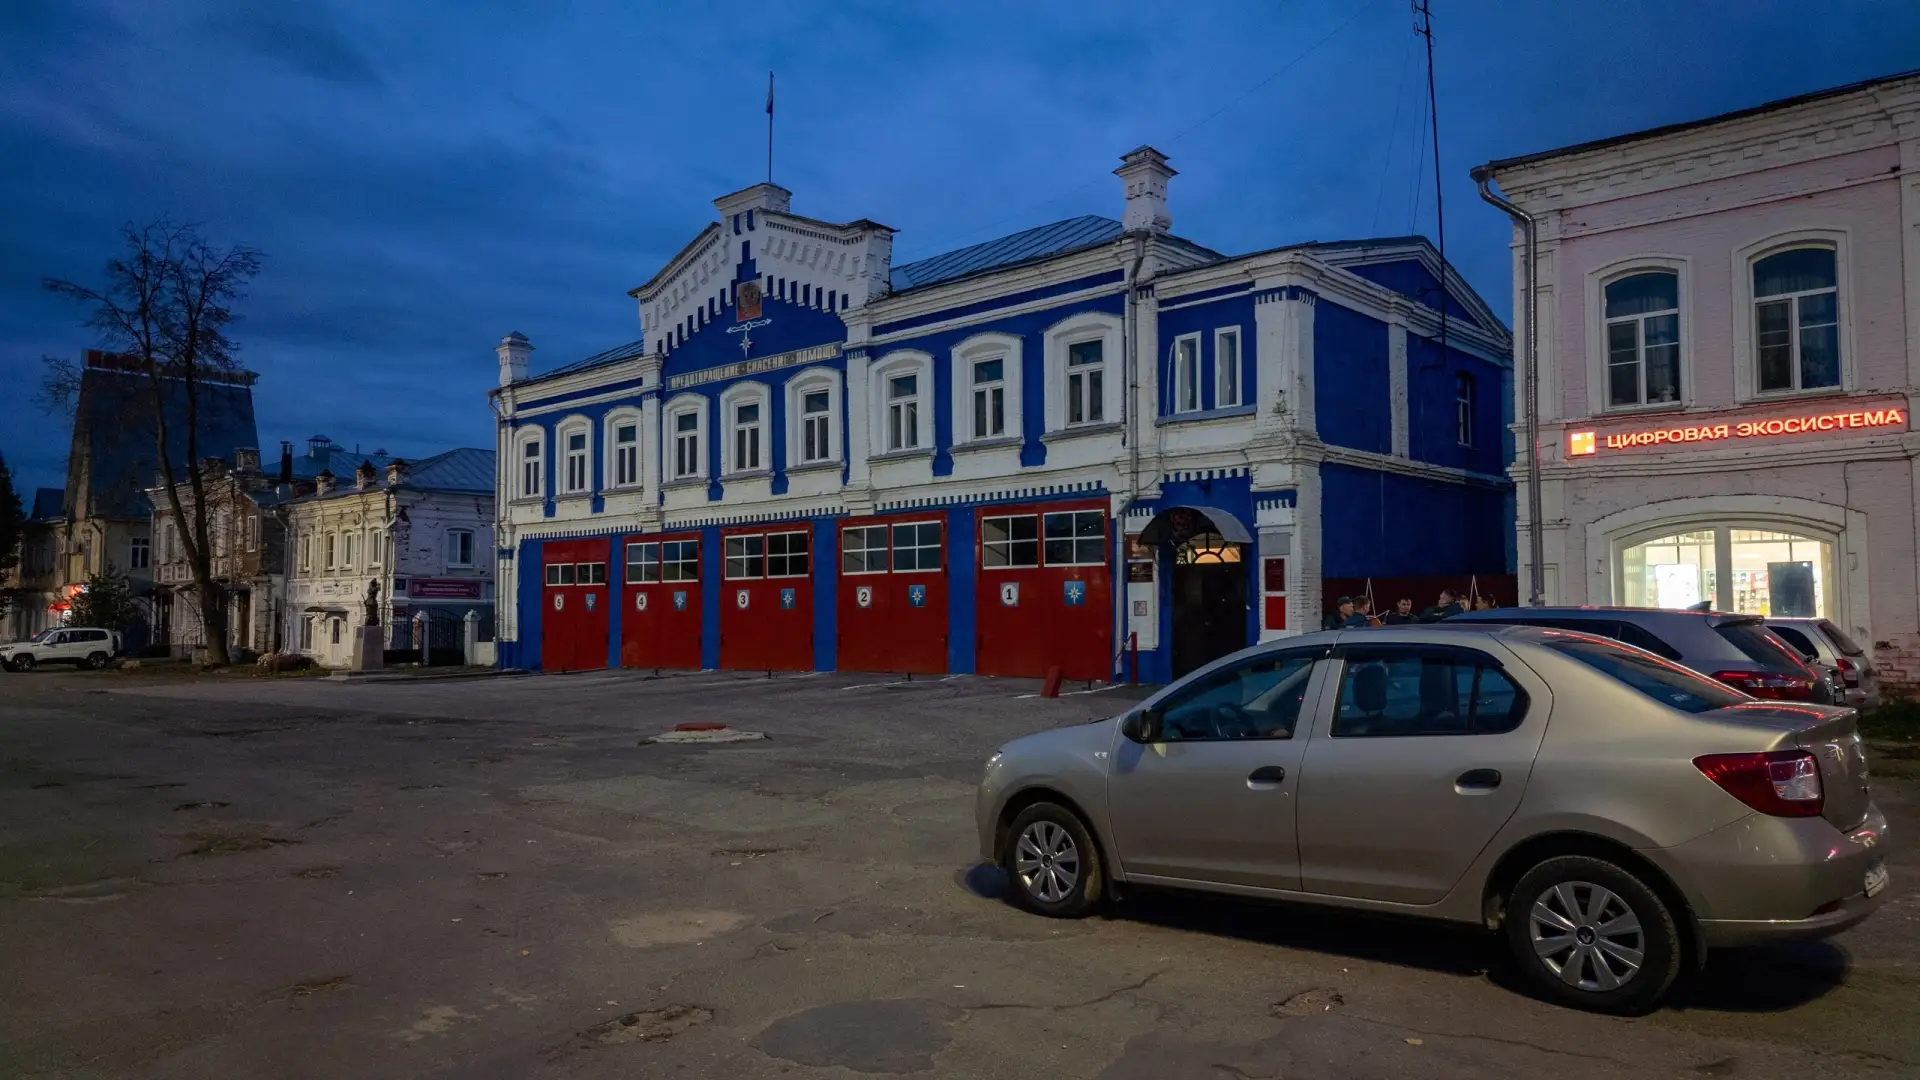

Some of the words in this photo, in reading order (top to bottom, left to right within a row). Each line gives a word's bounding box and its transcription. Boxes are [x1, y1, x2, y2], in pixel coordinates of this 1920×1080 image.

[671, 365, 740, 388] ПРЕДОТВРАЩЕНИЕ
[746, 354, 789, 373] СПАСЕНИЕ
[796, 345, 837, 364] ПОМОЩЬ
[1607, 424, 1729, 449] ЦИФРОВАЯ
[1736, 409, 1903, 437] ЭКОСИСТЕМА
